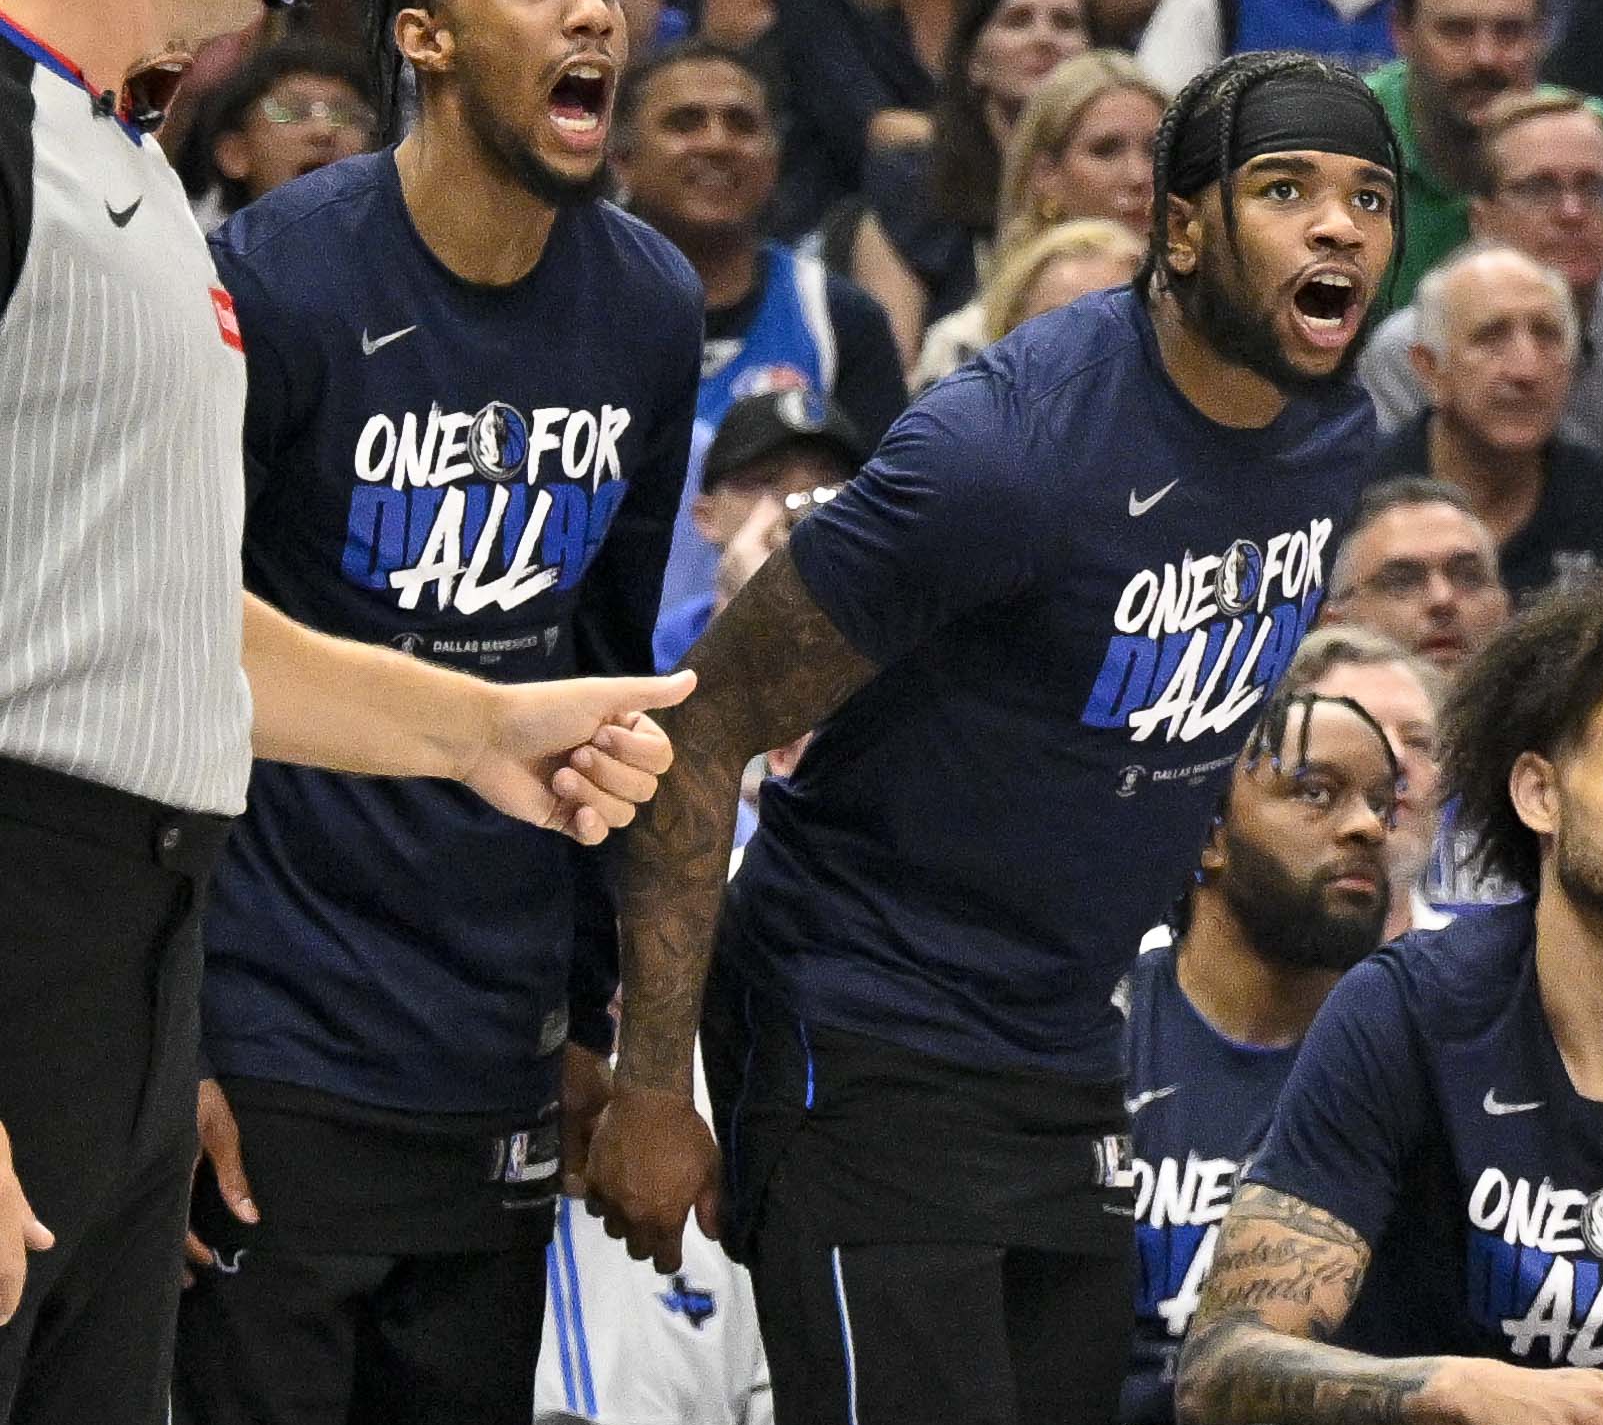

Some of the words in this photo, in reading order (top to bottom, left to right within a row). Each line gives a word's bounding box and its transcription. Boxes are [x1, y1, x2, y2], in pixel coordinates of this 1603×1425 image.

[354, 400, 476, 491] ONE
[527, 404, 631, 496] FOR
[388, 483, 561, 616] ALL
[1113, 548, 1223, 640] ONE
[1257, 517, 1333, 615] FOR
[1128, 614, 1276, 743] ALL
[1467, 1166, 1589, 1254] ONE
